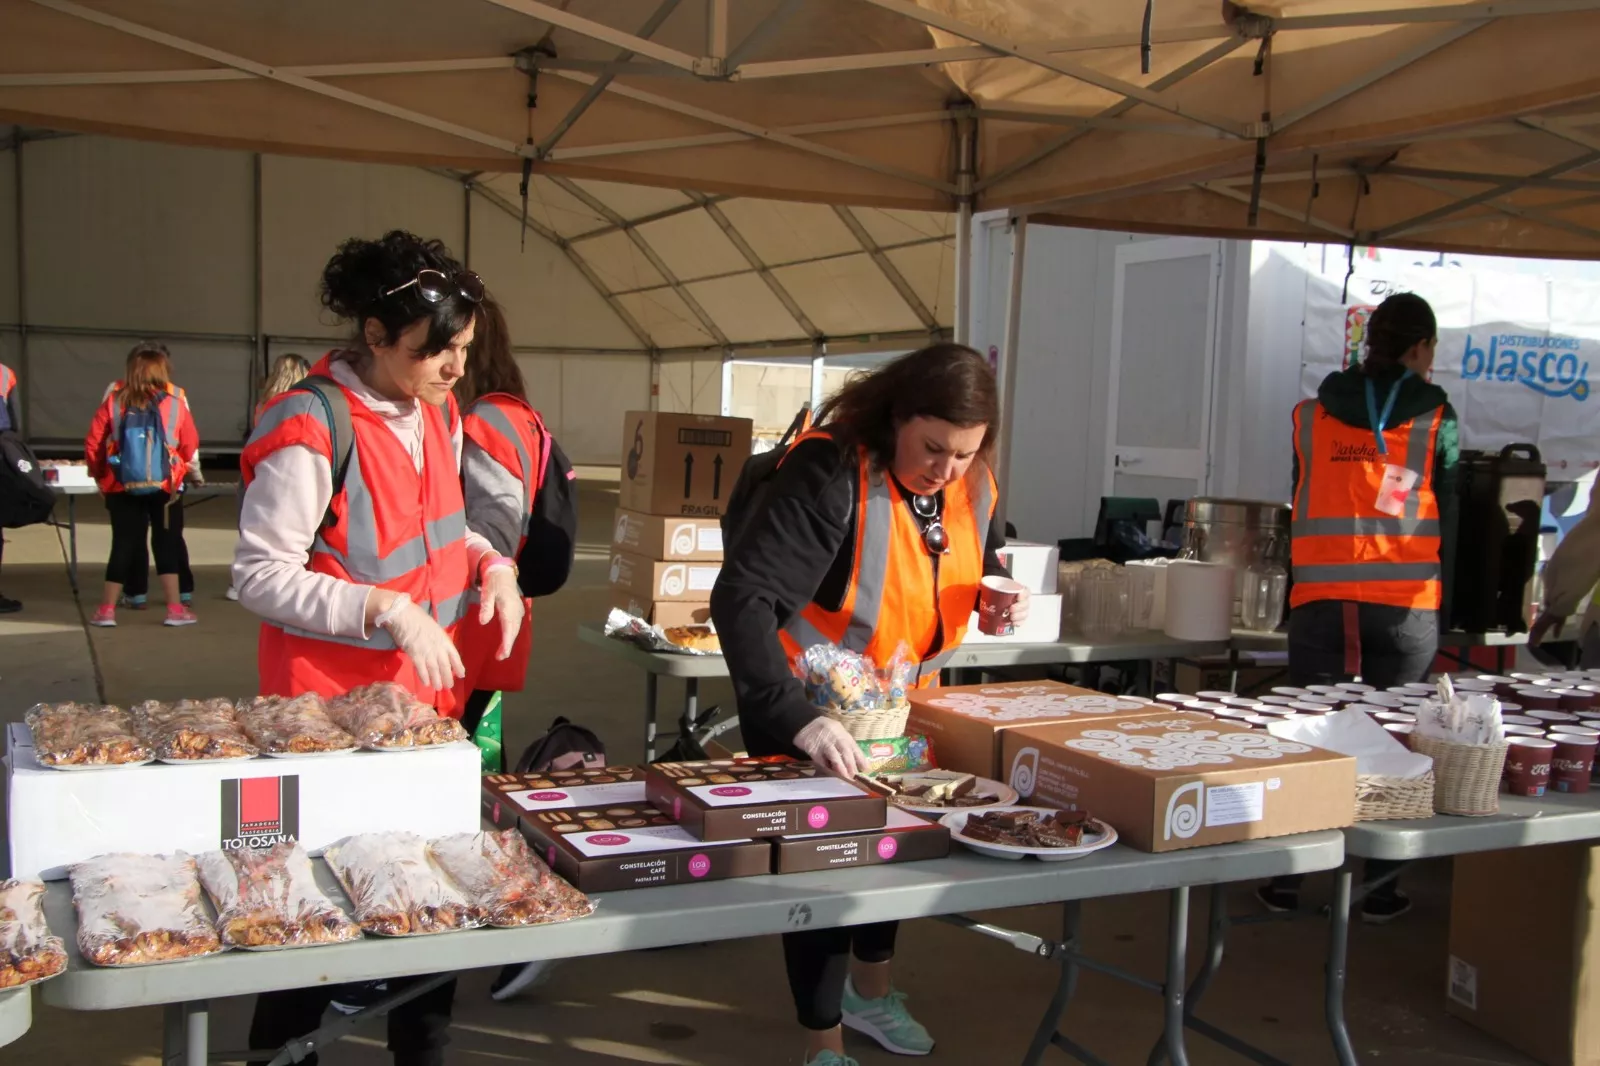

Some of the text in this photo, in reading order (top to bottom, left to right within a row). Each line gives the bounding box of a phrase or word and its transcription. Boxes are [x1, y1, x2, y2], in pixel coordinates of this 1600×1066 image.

[742, 810, 787, 820] CONSTELACIÓN
[223, 834, 296, 850] TOLOSANA
[816, 841, 858, 852] CONSTELACIÓN
[843, 848, 858, 856] CAFÉ
[620, 859, 666, 870] CONSTELACIÓN
